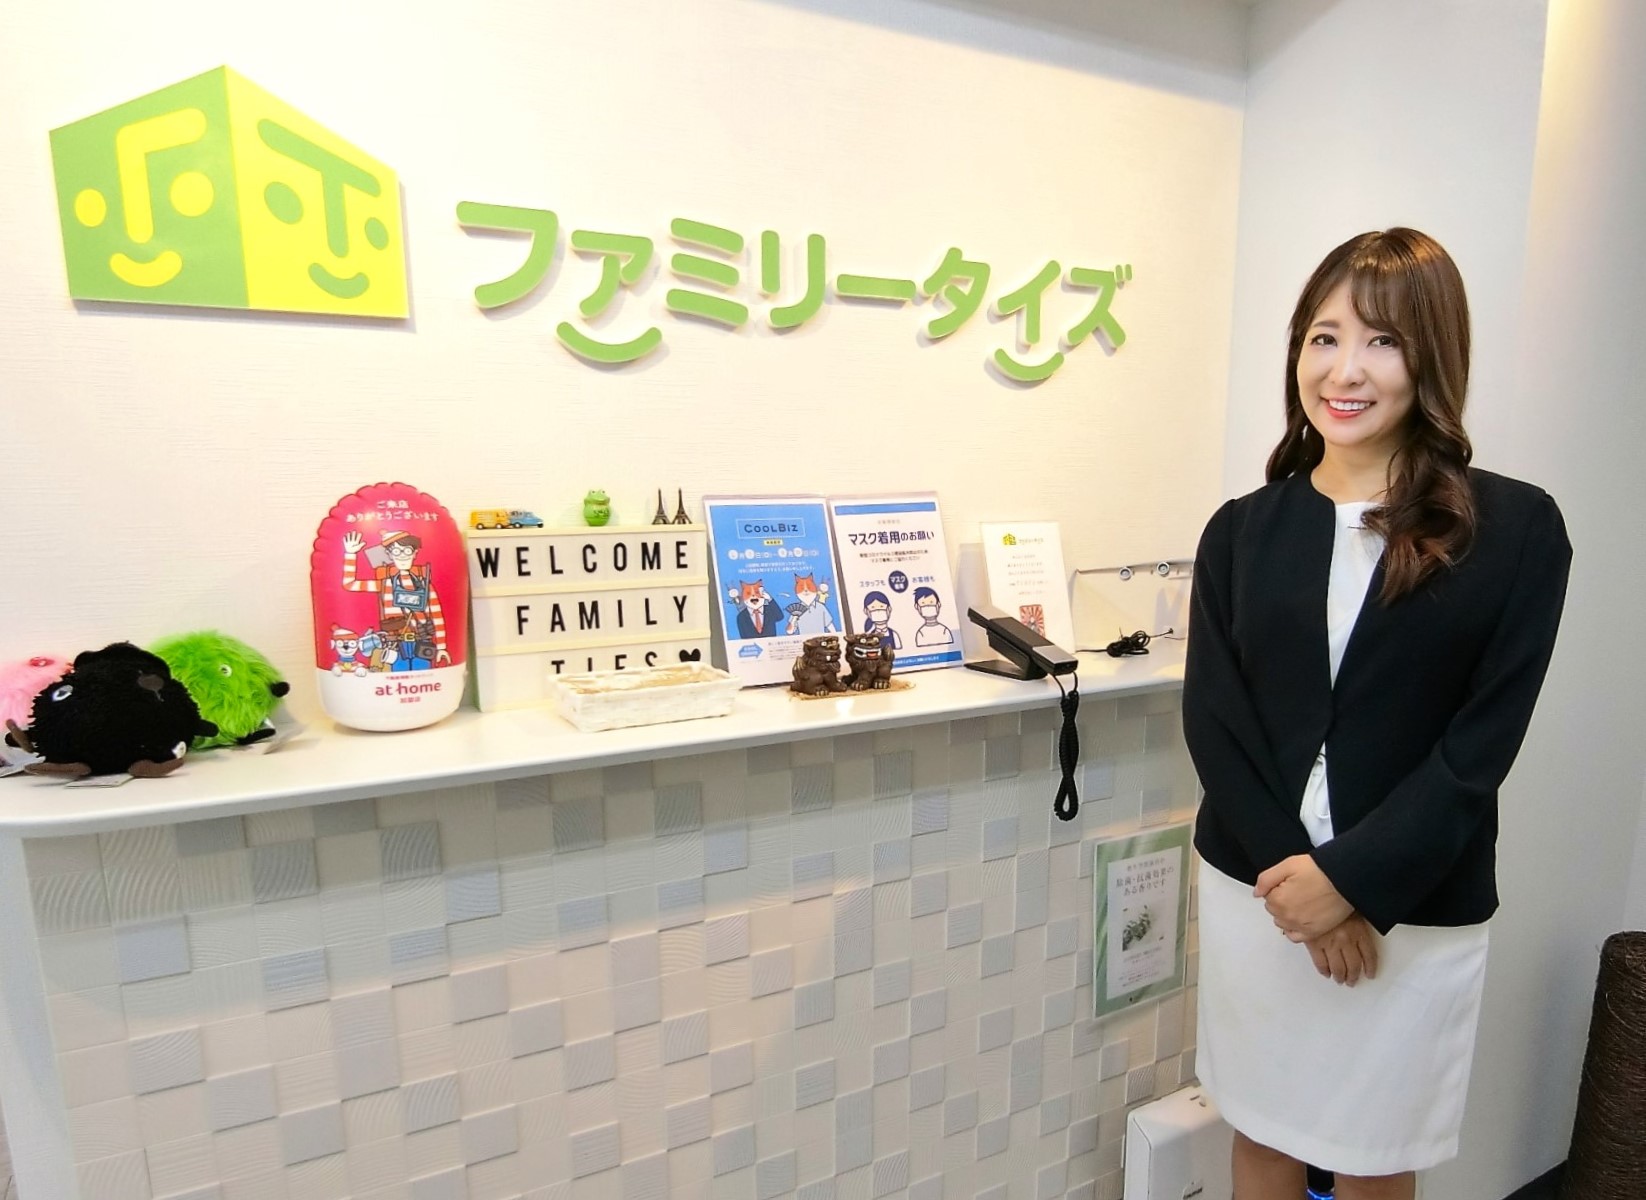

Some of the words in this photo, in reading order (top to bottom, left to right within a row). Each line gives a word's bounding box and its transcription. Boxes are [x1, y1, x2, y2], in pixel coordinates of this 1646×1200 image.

[456, 201, 1132, 348] ファミリータイズ
[377, 499, 409, 509] ご来店
[346, 510, 439, 523] ありがとうございます
[848, 530, 935, 546] マスク着用のお願い
[476, 541, 688, 578] WELCOME
[516, 595, 688, 635] FAMILY
[375, 684, 393, 696] at
[396, 682, 442, 695] home
